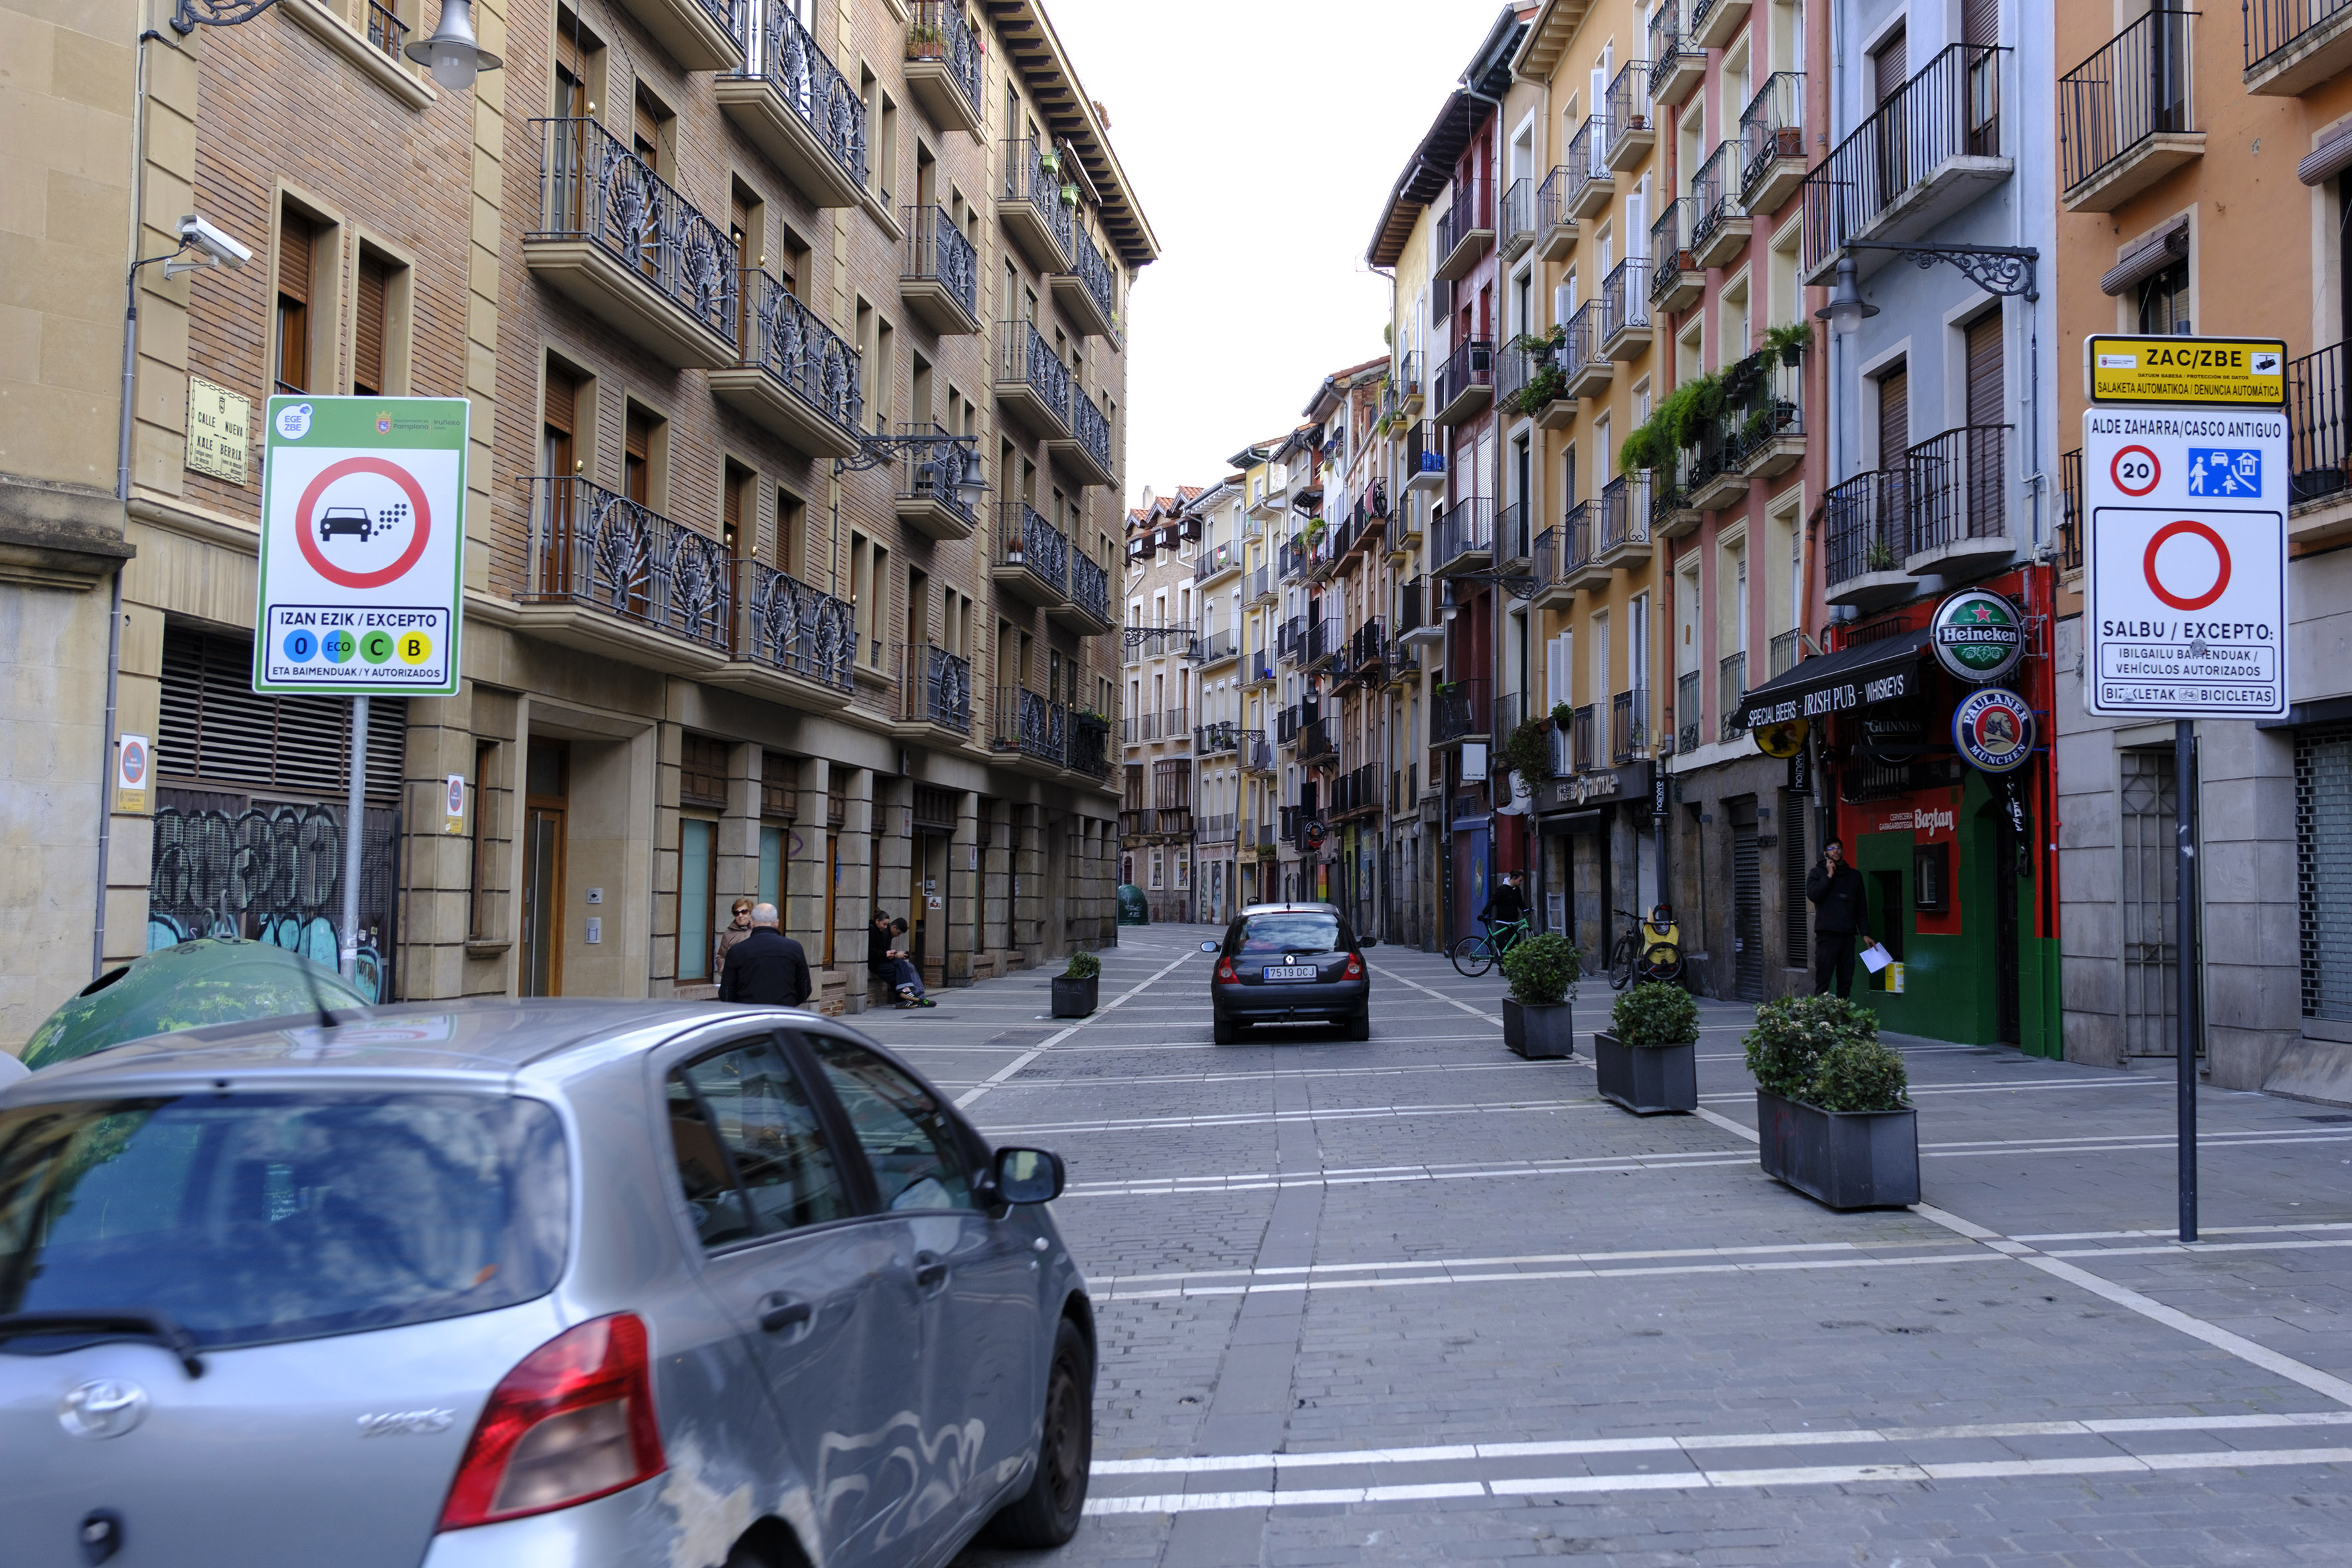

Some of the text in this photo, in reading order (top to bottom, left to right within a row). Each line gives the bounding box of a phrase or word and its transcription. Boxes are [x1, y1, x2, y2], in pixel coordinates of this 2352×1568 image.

[2146, 349, 2242, 369] ZAC/ZBE
[2098, 382, 2136, 393] SALAKETA
[2137, 383, 2189, 394] AUTOMATIKOA
[2194, 384, 2231, 396] DENUNCIA
[2233, 382, 2280, 397] AUTOMÁTICA
[198, 412, 243, 437] CALLE NUEVA
[2092, 418, 2281, 438] ALDE ZAHARRA/CASCO ANTIGUO
[196, 435, 213, 451] KALE
[220, 443, 242, 462] BERRIA
[2123, 463, 2150, 479] 20
[280, 612, 316, 625] IZAN
[321, 613, 355, 626] EZIK
[366, 613, 437, 627] EXCEPTO
[1942, 627, 2017, 642] Heineken
[2102, 621, 2165, 637] SALBU
[2184, 623, 2273, 640] EXCEPTO:
[327, 641, 351, 652] ECO
[370, 639, 384, 656] C
[408, 639, 421, 656] B
[2119, 648, 2173, 659] IBILGAILU
[2177, 649, 2251, 661] BAENDUAK
[273, 666, 290, 675] ETA
[293, 667, 357, 676] BAIMENDUAK
[372, 668, 441, 677] AUTORIZADOS
[2116, 663, 2260, 676] VEHÍCULOS AUTORIZADOS
[1748, 706, 1776, 728] SPECIAL
[1776, 700, 1796, 722] BEERS
[1804, 690, 1832, 716] IRISH
[1833, 684, 1856, 710] PUB
[1865, 674, 1904, 703] WHISKEYS
[2201, 689, 2272, 702] BICICLETAS
[1963, 694, 2028, 725] PAULANER
[1869, 720, 1922, 732] GUINNESS
[1969, 744, 2026, 765] MÜNCHEN
[1890, 813, 1913, 821] CERVECERIA
[1915, 807, 1954, 837] Baztan
[1270, 967, 1314, 977] 7519 DCJ
